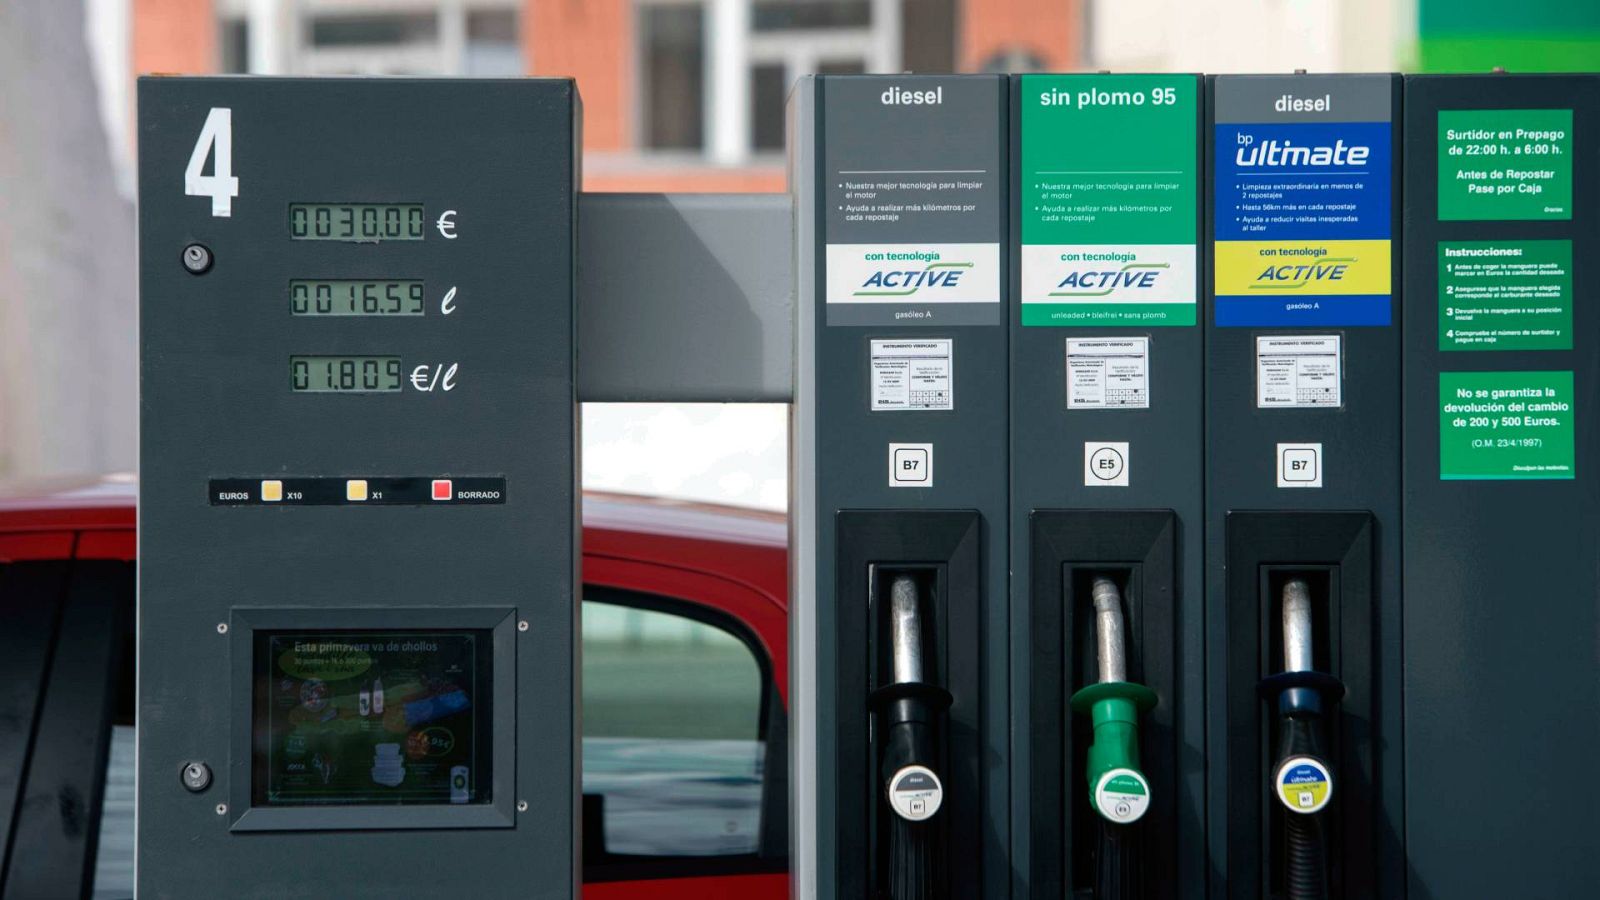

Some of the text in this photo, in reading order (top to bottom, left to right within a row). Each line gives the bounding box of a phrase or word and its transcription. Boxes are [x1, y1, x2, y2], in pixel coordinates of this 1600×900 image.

[881, 86, 943, 105] diesel
[1040, 88, 1176, 109] sin plomo 95
[1275, 95, 1330, 112] diesel
[1237, 132, 1253, 147] bp
[1446, 129, 1565, 141] Surtidor en Prepago
[1236, 140, 1370, 166] ultimate
[1448, 144, 1563, 155] de 22:00 h. a 6:00 h.
[185, 107, 239, 217] 4
[1456, 169, 1555, 181] Antes de Repostar
[845, 182, 875, 190] Nuestra
[876, 182, 898, 191] mejor
[939, 183, 956, 191] para
[957, 181, 983, 191] limpiar
[1041, 182, 1071, 190] Nuestra
[1073, 182, 1094, 191] mejor
[1136, 183, 1152, 192] para
[1153, 182, 1180, 191] limpiar
[1242, 183, 1272, 191] Limpieza
[1468, 183, 1542, 195] Pase por Caja
[1249, 192, 1282, 200] repostajes
[845, 205, 870, 213] Ayuda
[877, 204, 904, 212] realizar
[963, 205, 976, 213] por
[1041, 205, 1066, 213] Ayuda
[1325, 203, 1357, 212] repostaje
[292, 208, 423, 237] 0030.00
[865, 213, 899, 222] repostaje
[1061, 214, 1095, 223] repostaje
[1242, 216, 1263, 224] Ayuda
[1318, 215, 1359, 223] inesperadas
[436, 210, 458, 239] €
[865, 251, 940, 263] con tecnología
[1061, 253, 1080, 261] con
[1445, 247, 1523, 257] Instrucciones:
[1257, 265, 1348, 281] ACTIVE
[1446, 264, 1452, 272] 1
[862, 271, 964, 288] ACTIVE
[1058, 271, 1160, 288] ACTIVE
[292, 284, 424, 314] 0016.59
[895, 310, 924, 319] gasóleo
[1142, 312, 1167, 320] plomb
[1446, 330, 1454, 338] 4
[293, 360, 401, 390] 01.809
[1457, 387, 1555, 400] No se garantiza la
[1444, 402, 1569, 413] devolución del cambio
[1453, 416, 1560, 429] de 200 y 500 Euros.
[1497, 438, 1542, 448] 23/4/1997)
[903, 460, 919, 470] B7
[1099, 459, 1115, 469] E5
[1292, 460, 1308, 470] B7
[219, 492, 249, 500] EUROS
[458, 491, 500, 499] BORRADO
